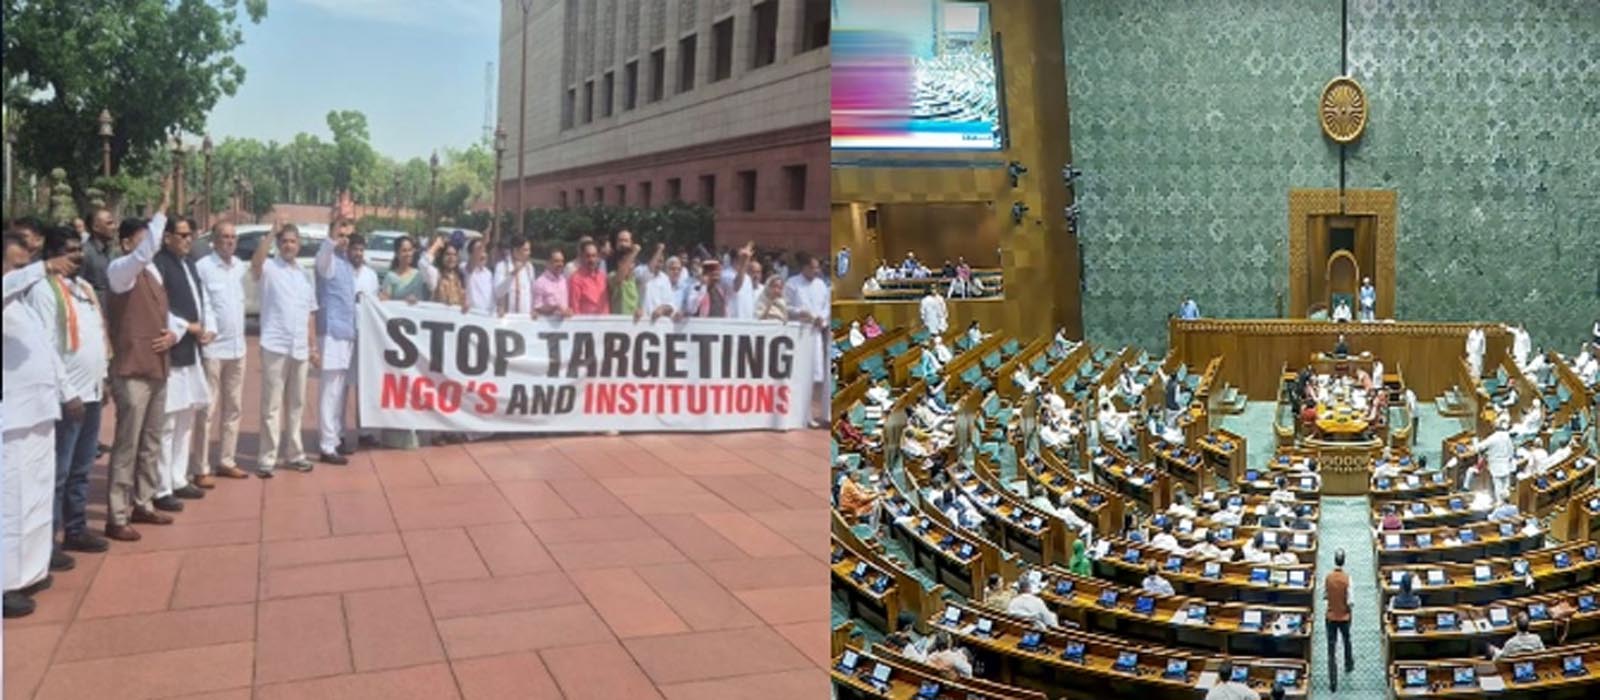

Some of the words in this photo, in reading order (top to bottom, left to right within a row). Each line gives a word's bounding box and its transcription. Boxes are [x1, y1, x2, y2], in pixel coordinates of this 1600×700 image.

[383, 317, 526, 376] STOP
[538, 331, 794, 379] TARGETING
[380, 373, 497, 415] NGO'S
[505, 383, 576, 415] AND
[583, 383, 790, 415] INSTITUTIONS
